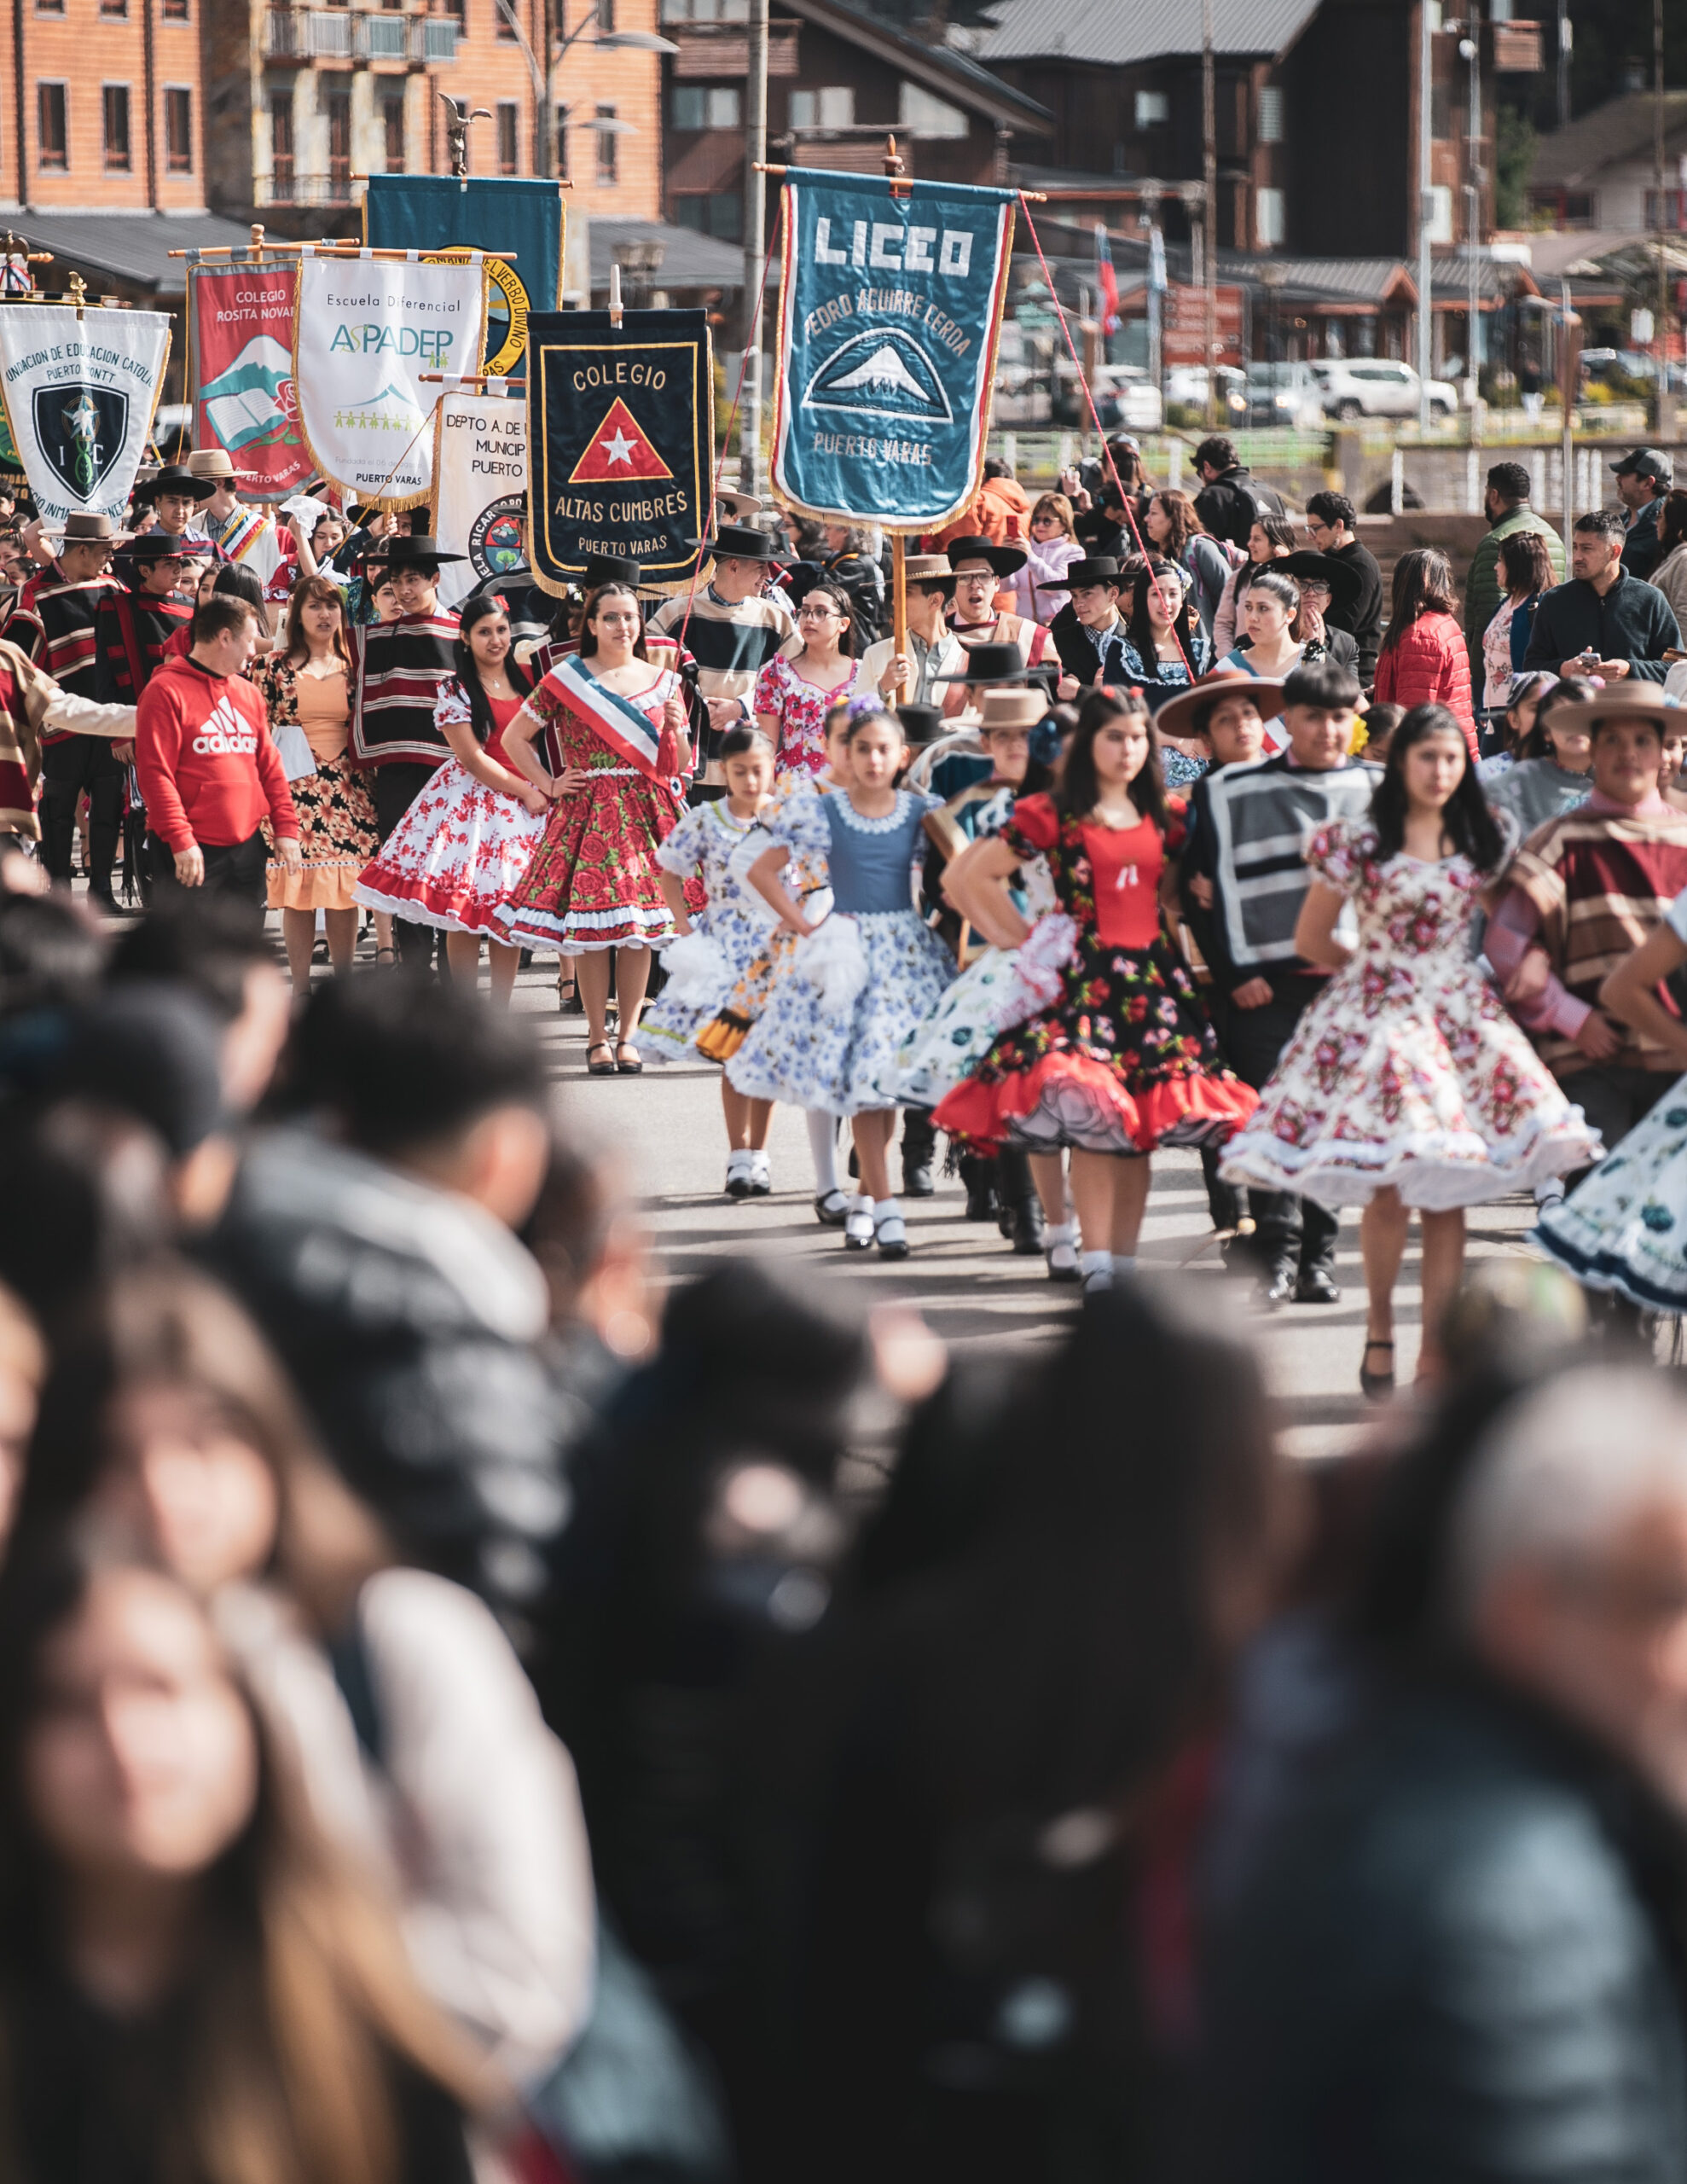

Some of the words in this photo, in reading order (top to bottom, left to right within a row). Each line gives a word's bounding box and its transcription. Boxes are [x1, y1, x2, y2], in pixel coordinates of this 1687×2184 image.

[815, 217, 974, 277] LICEO
[235, 289, 287, 303] COLEGIO
[497, 266, 525, 305] VERBO
[328, 293, 380, 307] Escuela
[388, 295, 461, 311] Diferencial
[217, 308, 258, 322] ROSITA
[804, 293, 853, 345] PEDRO
[857, 288, 925, 318] AGUIRRE
[924, 303, 971, 358] CERDA
[510, 307, 527, 348] DIVINO
[329, 324, 454, 369] ASPADEP
[5, 349, 49, 382] UNDACION
[50, 346, 64, 361] DE
[46, 363, 81, 380] PUERTO
[85, 365, 117, 383] ONTT
[573, 363, 666, 392] COLEGIO
[446, 415, 487, 432] DEPTO
[491, 419, 502, 433] A.
[506, 421, 520, 436] DE
[814, 432, 877, 459] PUERTO
[884, 439, 933, 466] VARAS
[273, 461, 301, 483] VARAS
[356, 473, 393, 484] PUERTO
[395, 475, 422, 485] VARAS
[472, 460, 523, 477] PUERTO
[555, 497, 603, 523] ALTAS
[610, 491, 688, 523] CUMBRES
[578, 537, 626, 555] PUERTO
[630, 535, 668, 555] VARAS
[193, 732, 258, 754] adidas
